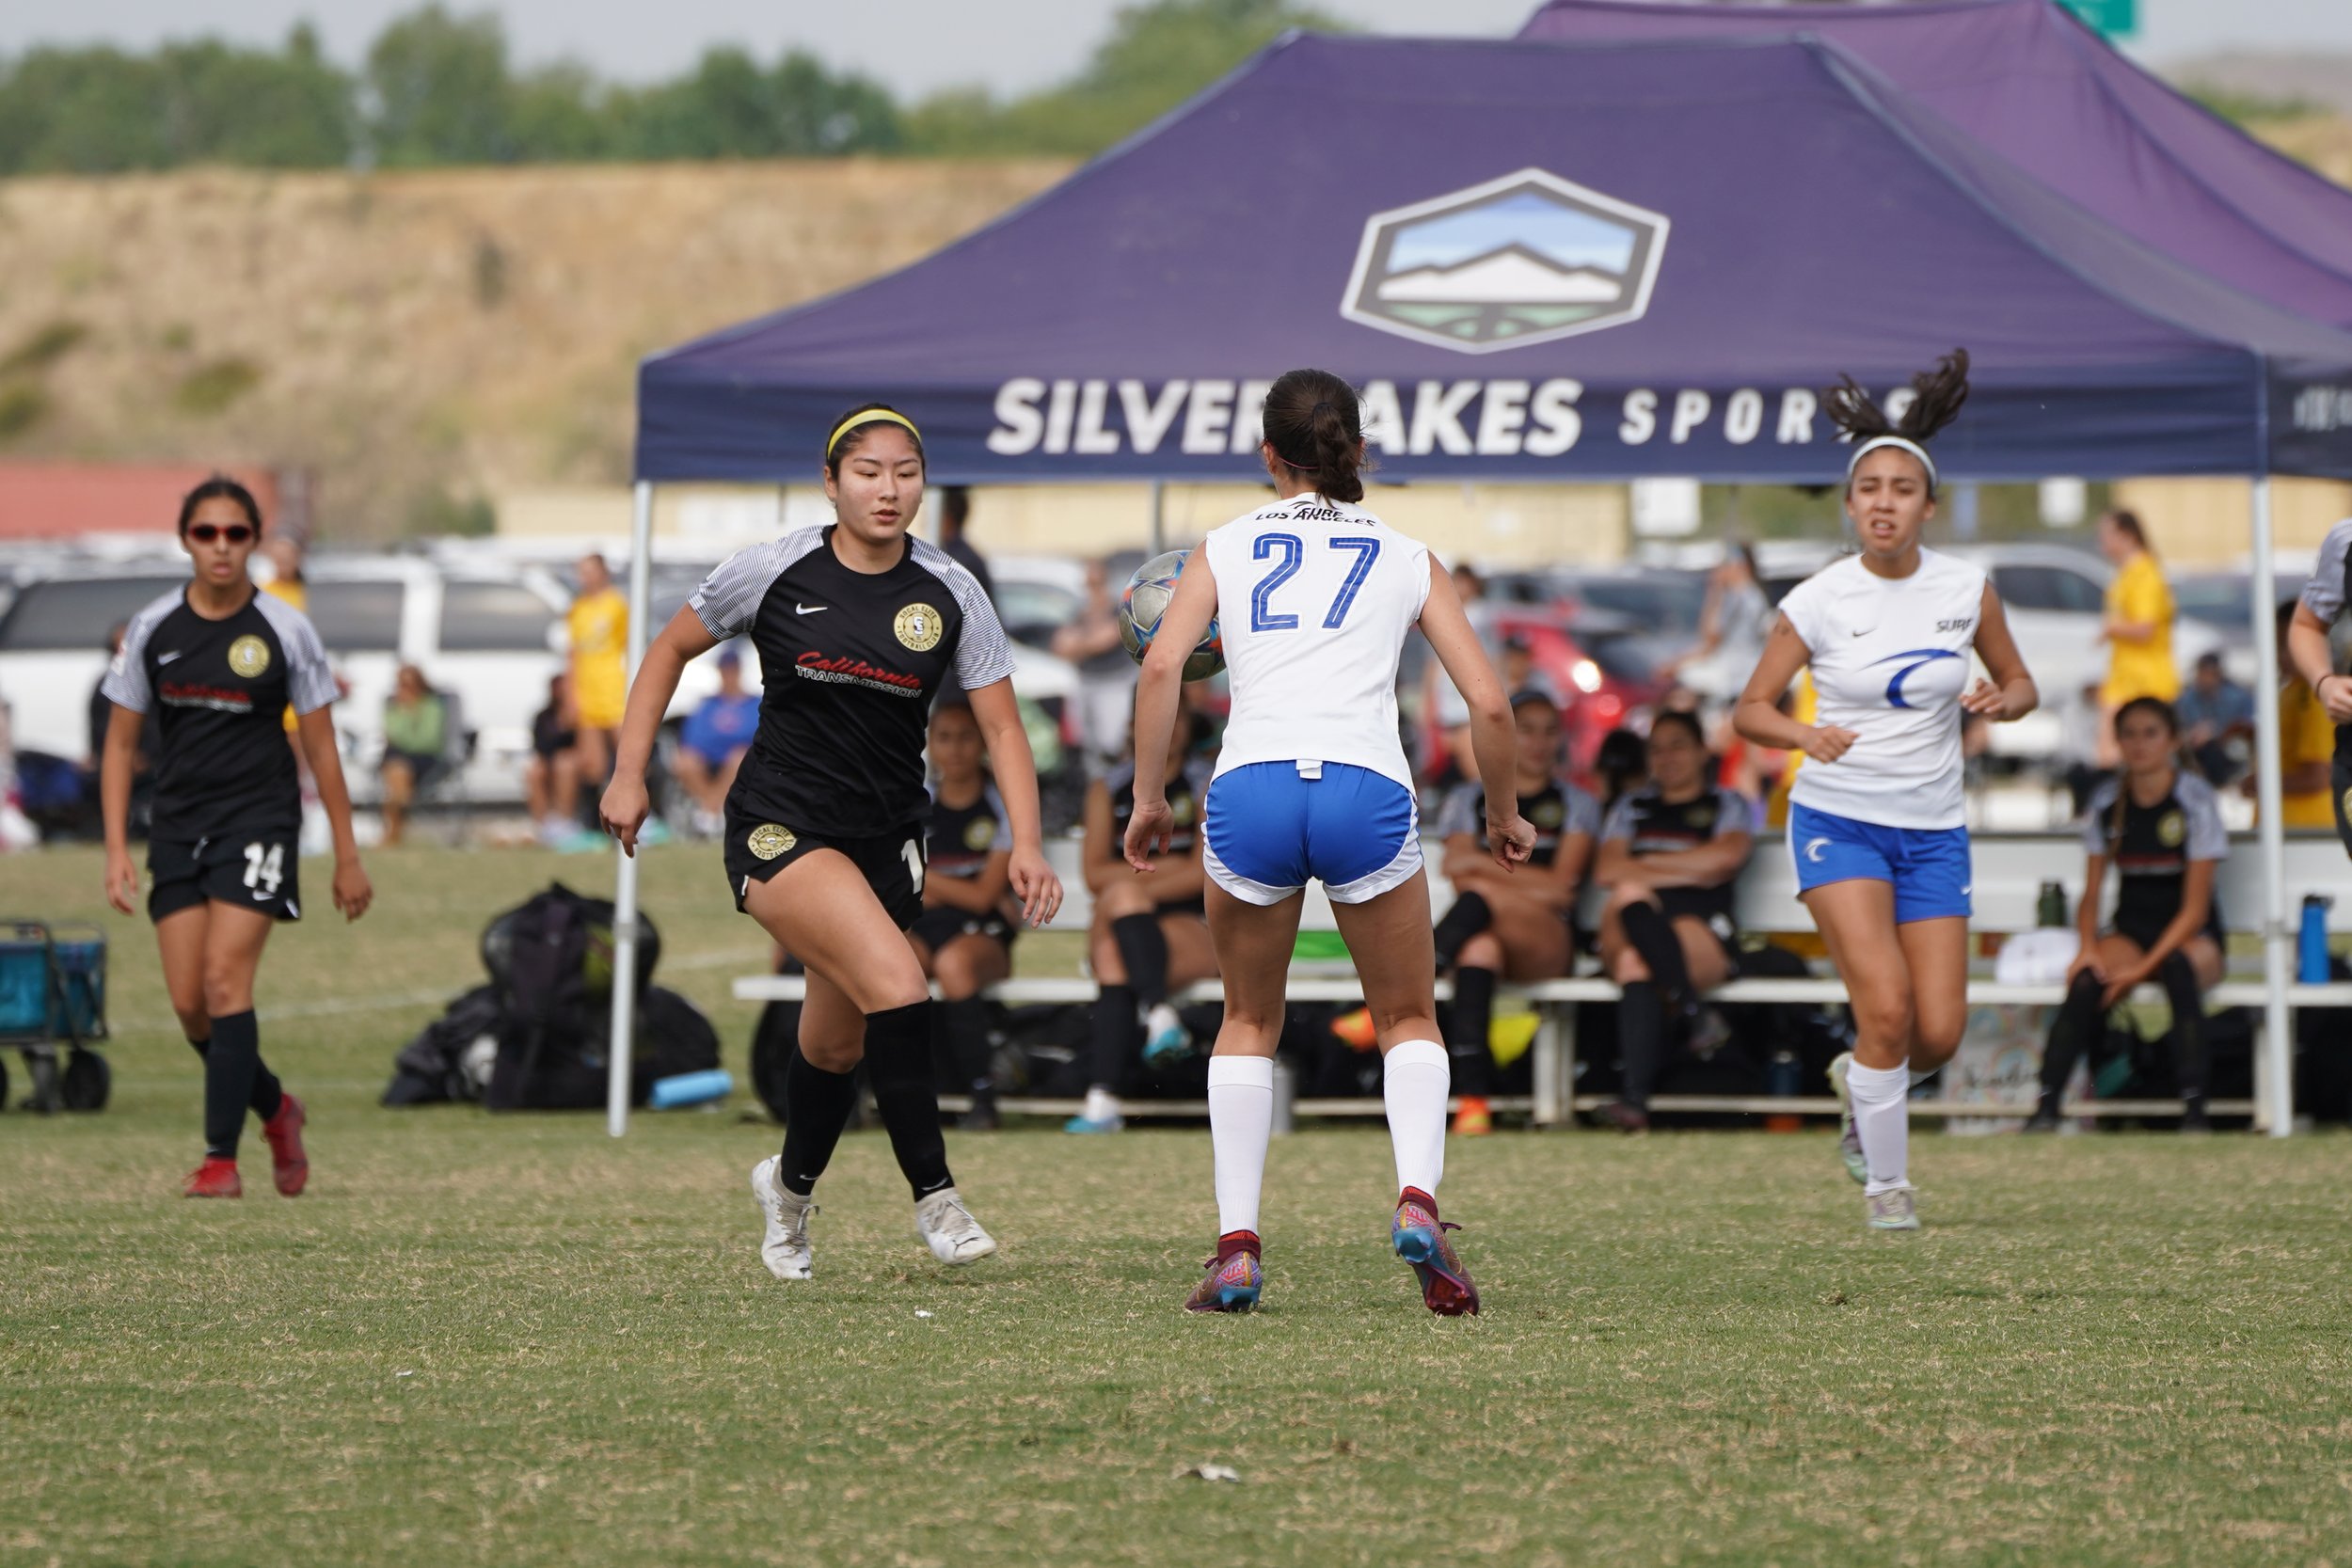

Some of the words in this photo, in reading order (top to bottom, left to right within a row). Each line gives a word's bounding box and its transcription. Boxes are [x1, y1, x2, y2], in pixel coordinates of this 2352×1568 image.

[986, 378, 1584, 456] SILVERAKES
[1255, 512, 1292, 521] LOS
[1251, 532, 1380, 633] 27
[921, 606, 937, 620] ELITE
[897, 630, 927, 650] FOOTBALL
[926, 632, 939, 647] CLUB
[795, 664, 923, 699] TRANSMISSION
[797, 651, 921, 689] California
[244, 842, 284, 894] 14
[900, 837, 929, 895] 1
